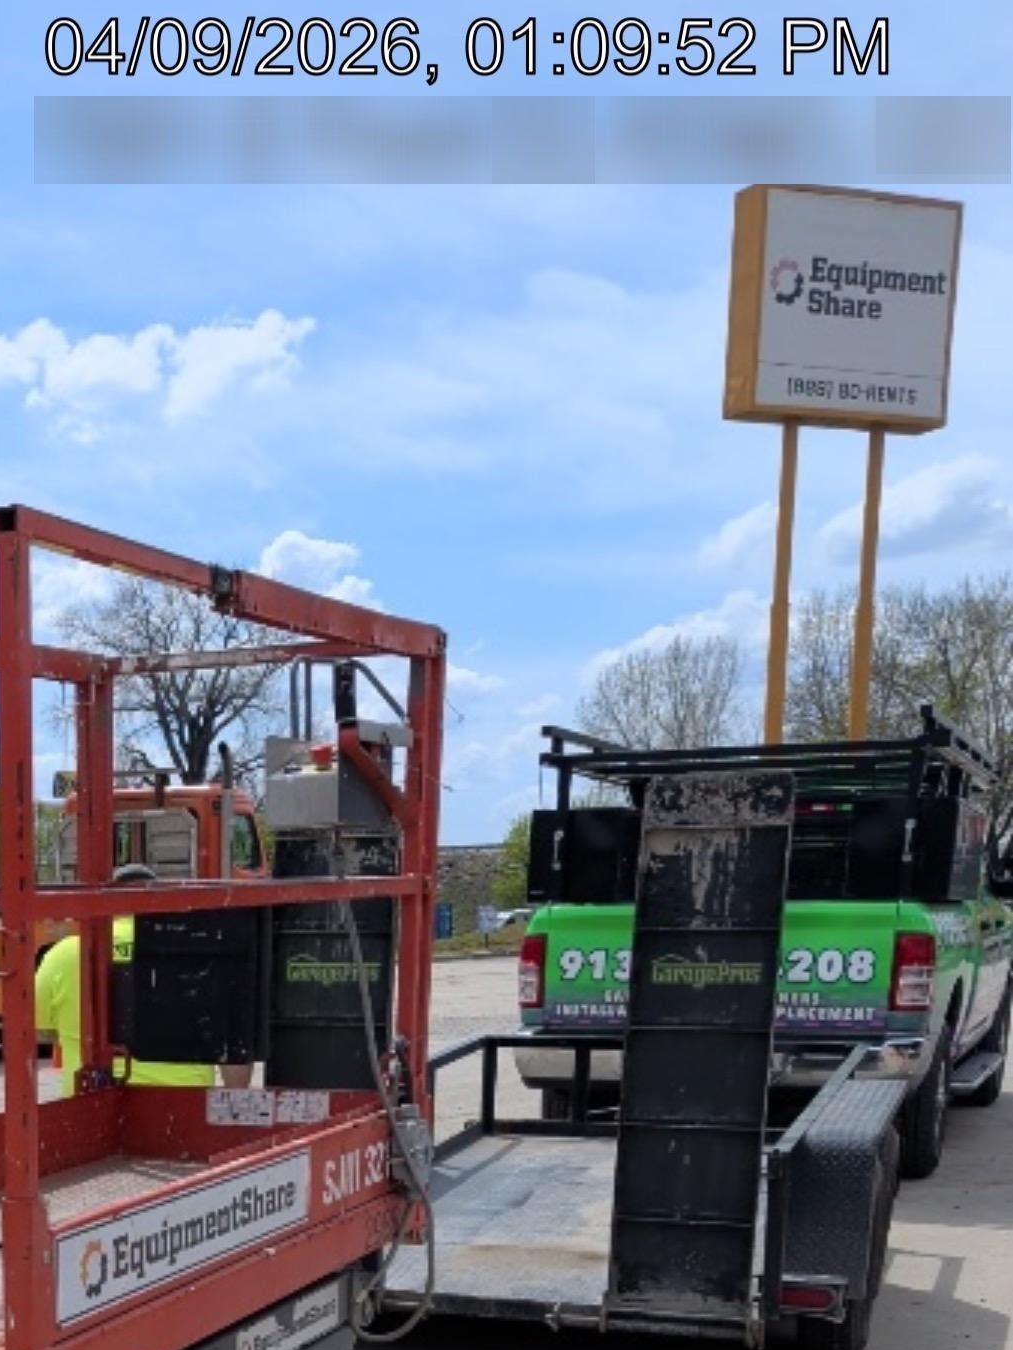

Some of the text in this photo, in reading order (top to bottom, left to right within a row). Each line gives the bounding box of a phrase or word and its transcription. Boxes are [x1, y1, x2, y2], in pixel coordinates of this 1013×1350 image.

[809, 256, 946, 295] Equipment
[806, 288, 882, 319] Share
[559, 948, 876, 982] 913 208
[113, 1181, 297, 1279] EquipmentShare
